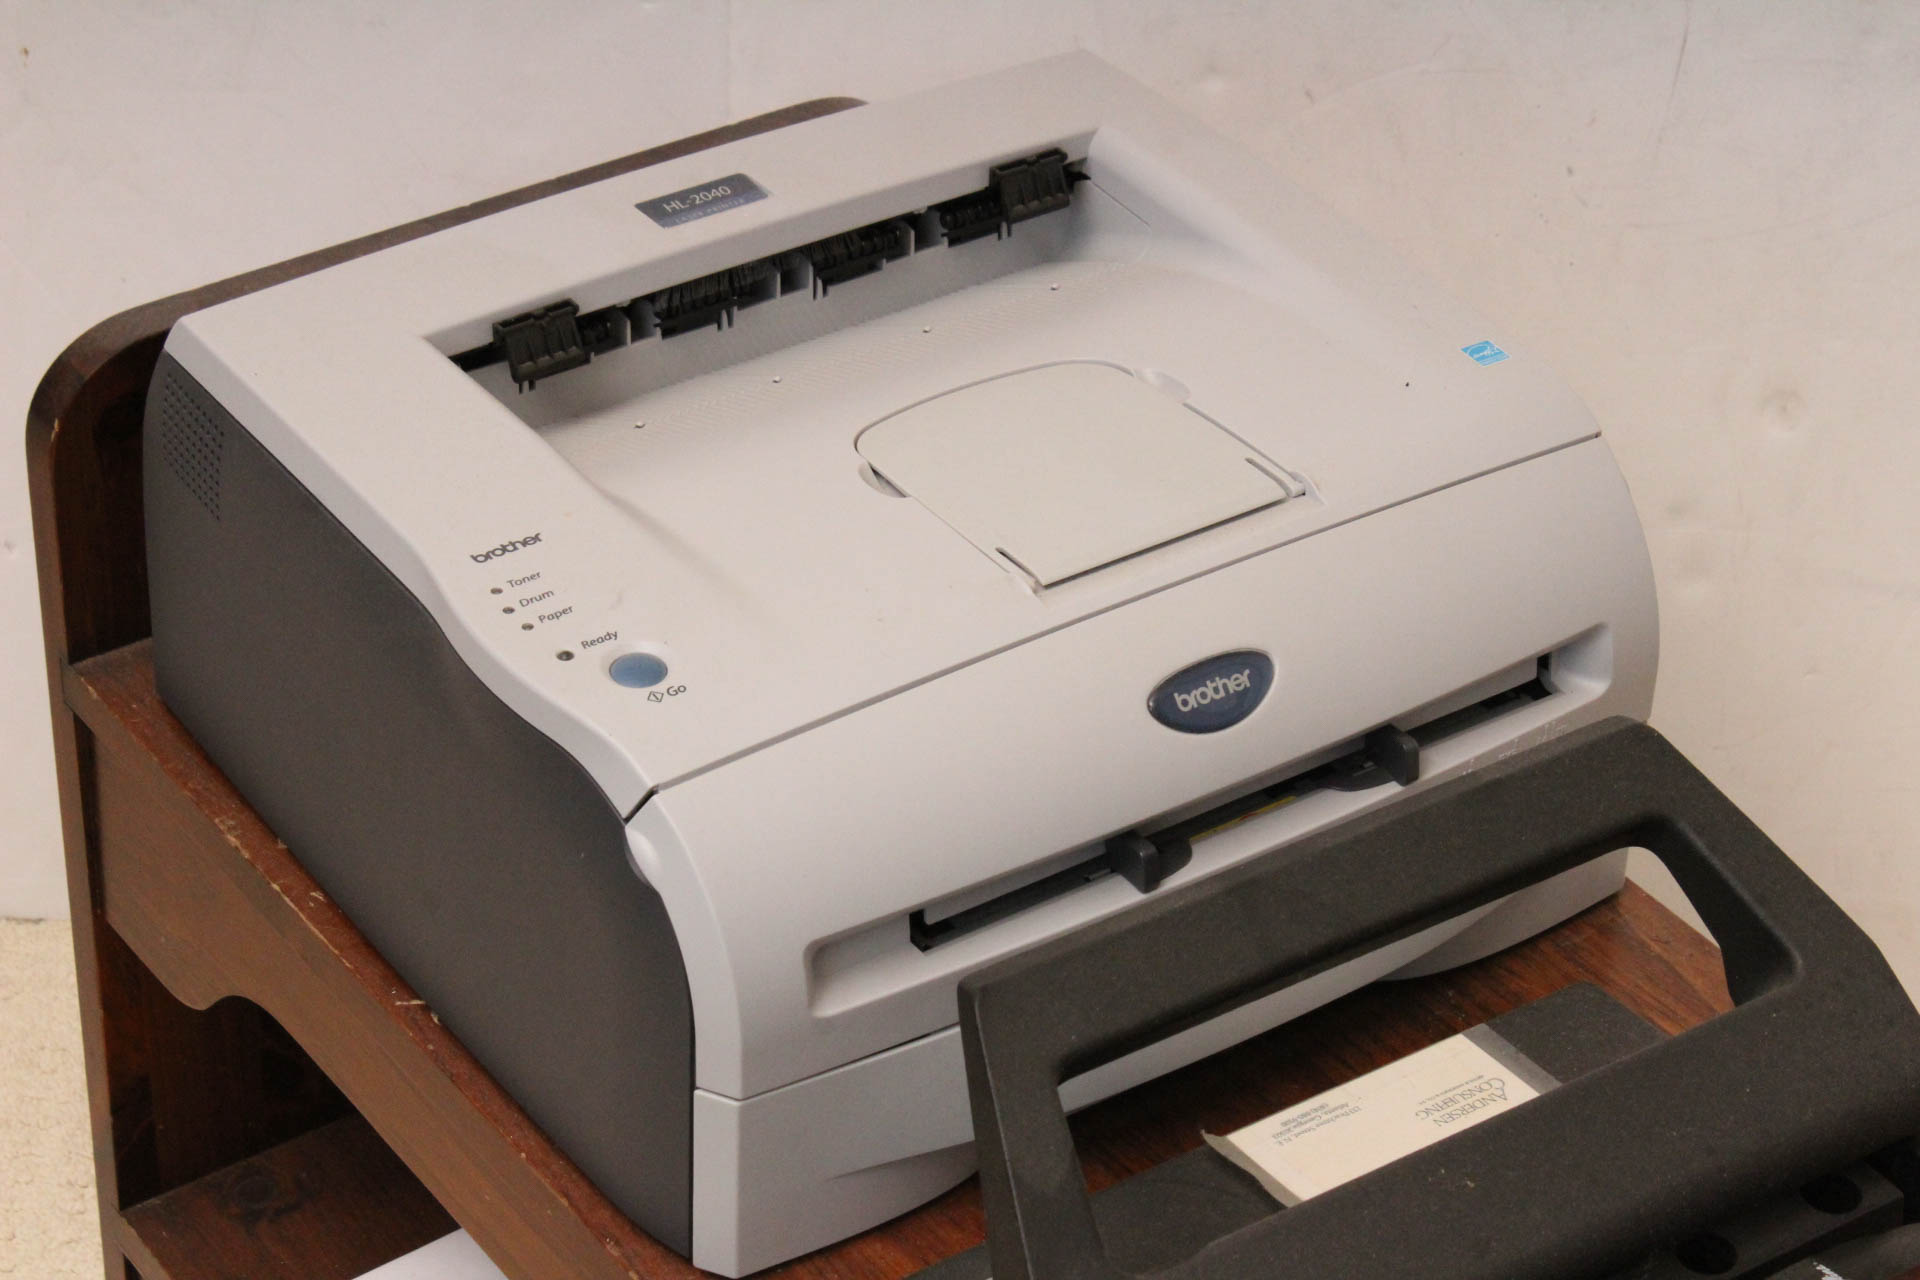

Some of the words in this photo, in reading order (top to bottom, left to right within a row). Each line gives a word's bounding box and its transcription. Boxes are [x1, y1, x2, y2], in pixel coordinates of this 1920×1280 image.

[662, 185, 731, 213] HL-2040
[470, 532, 543, 564] brother
[506, 570, 541, 588] Toner
[518, 589, 555, 608] Drum
[538, 605, 574, 624] Paper
[581, 630, 619, 650] Ready
[666, 684, 687, 697] Go
[1173, 669, 1251, 712] brother
[1433, 1087, 1508, 1127] ANDERSEN
